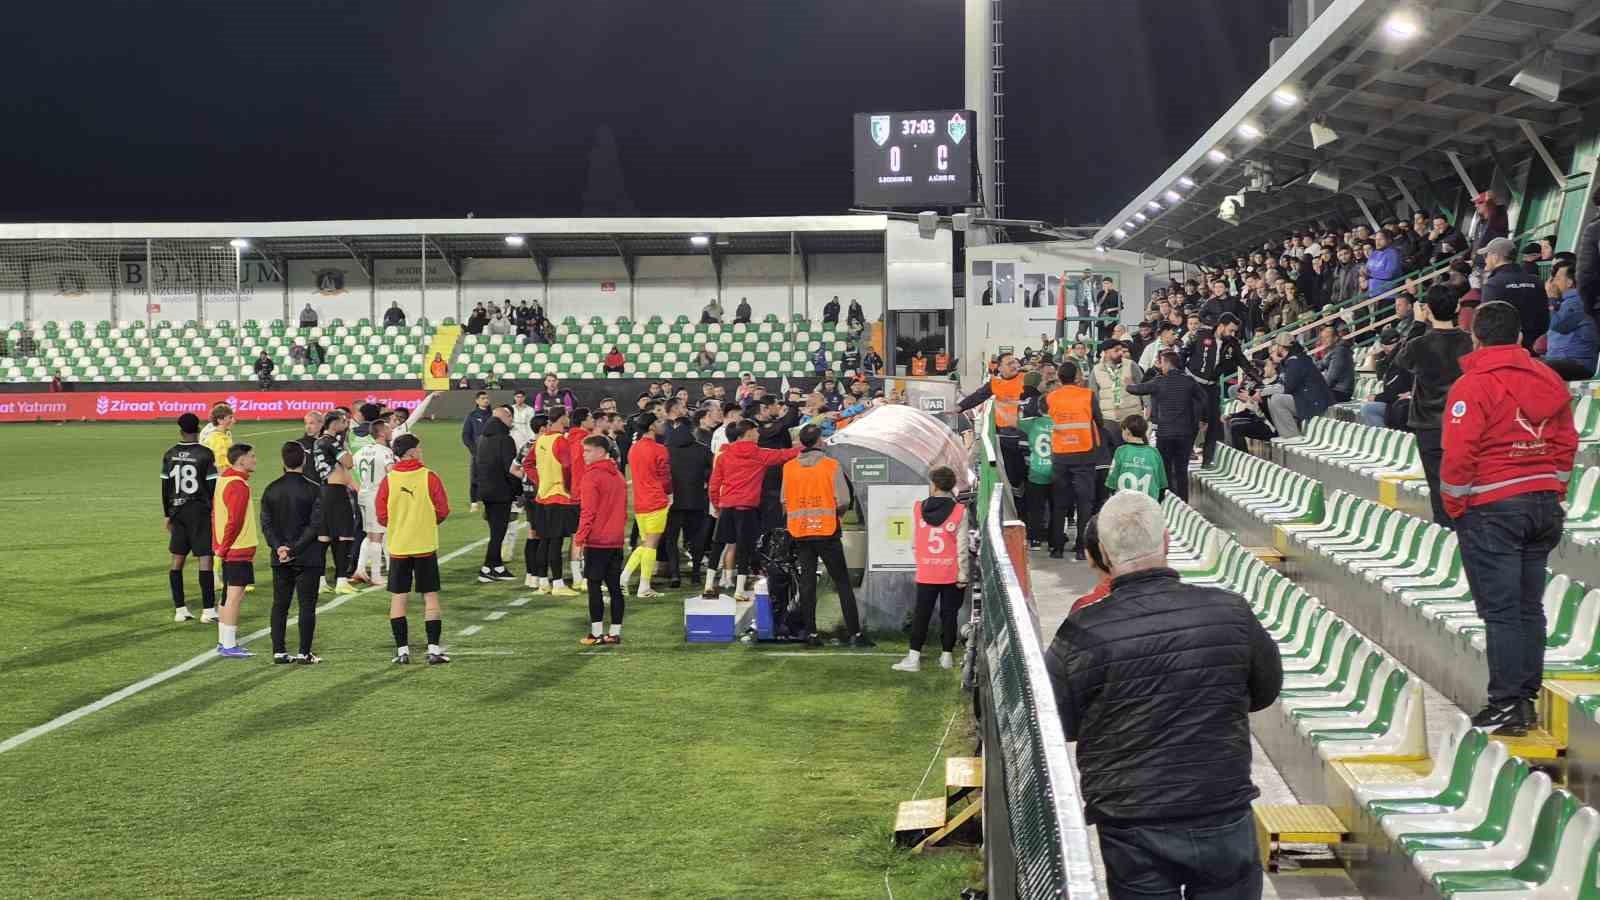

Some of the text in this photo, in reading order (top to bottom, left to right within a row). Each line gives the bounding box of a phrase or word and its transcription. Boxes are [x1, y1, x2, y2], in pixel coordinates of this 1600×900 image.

[901, 119, 936, 135] 37:03
[890, 146, 901, 172] 0
[111, 400, 154, 412] Ziraat
[239, 399, 283, 411] Ziraat
[922, 400, 944, 409] VAR
[169, 464, 199, 494] 18
[893, 521, 904, 535] T
[927, 527, 945, 554] 5
